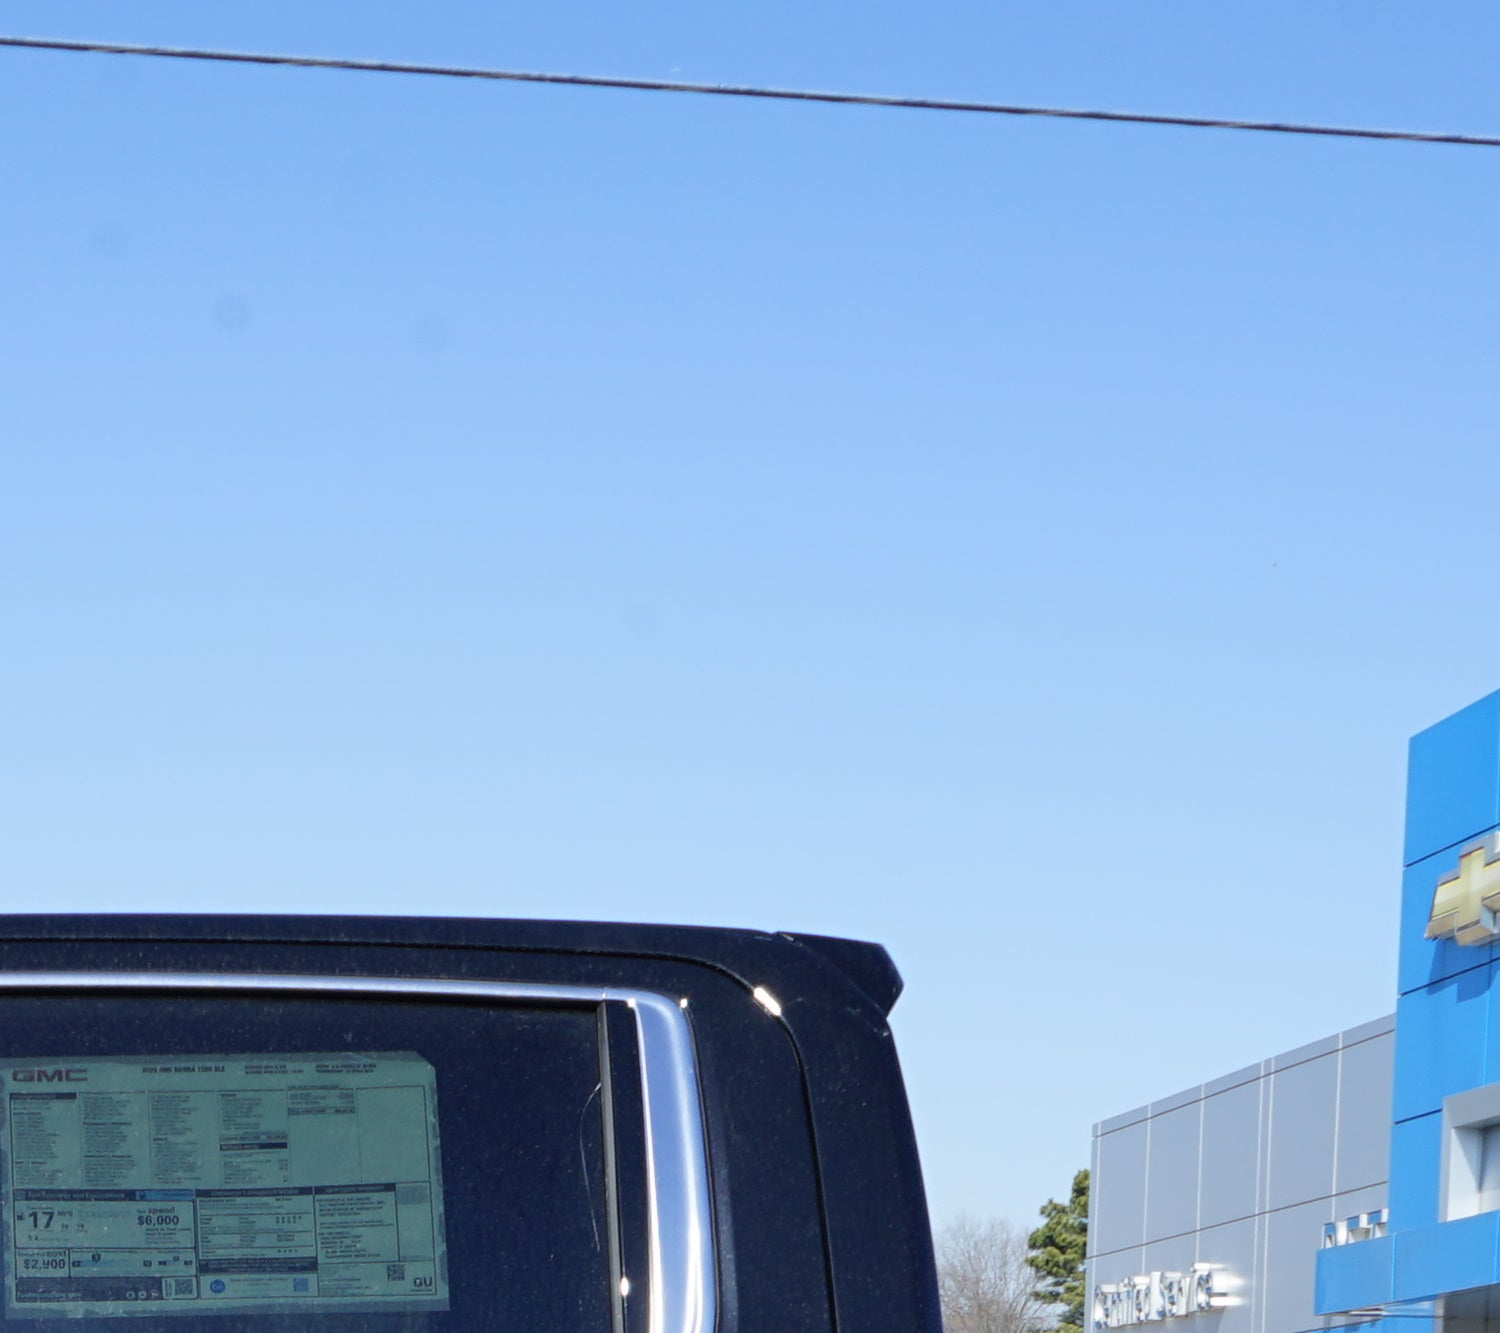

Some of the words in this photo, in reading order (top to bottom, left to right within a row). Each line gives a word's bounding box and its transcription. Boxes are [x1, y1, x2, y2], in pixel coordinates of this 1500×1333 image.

[12, 1068, 88, 1083] GMC
[28, 1211, 55, 1229] 17
[137, 1215, 180, 1227] $6,000
